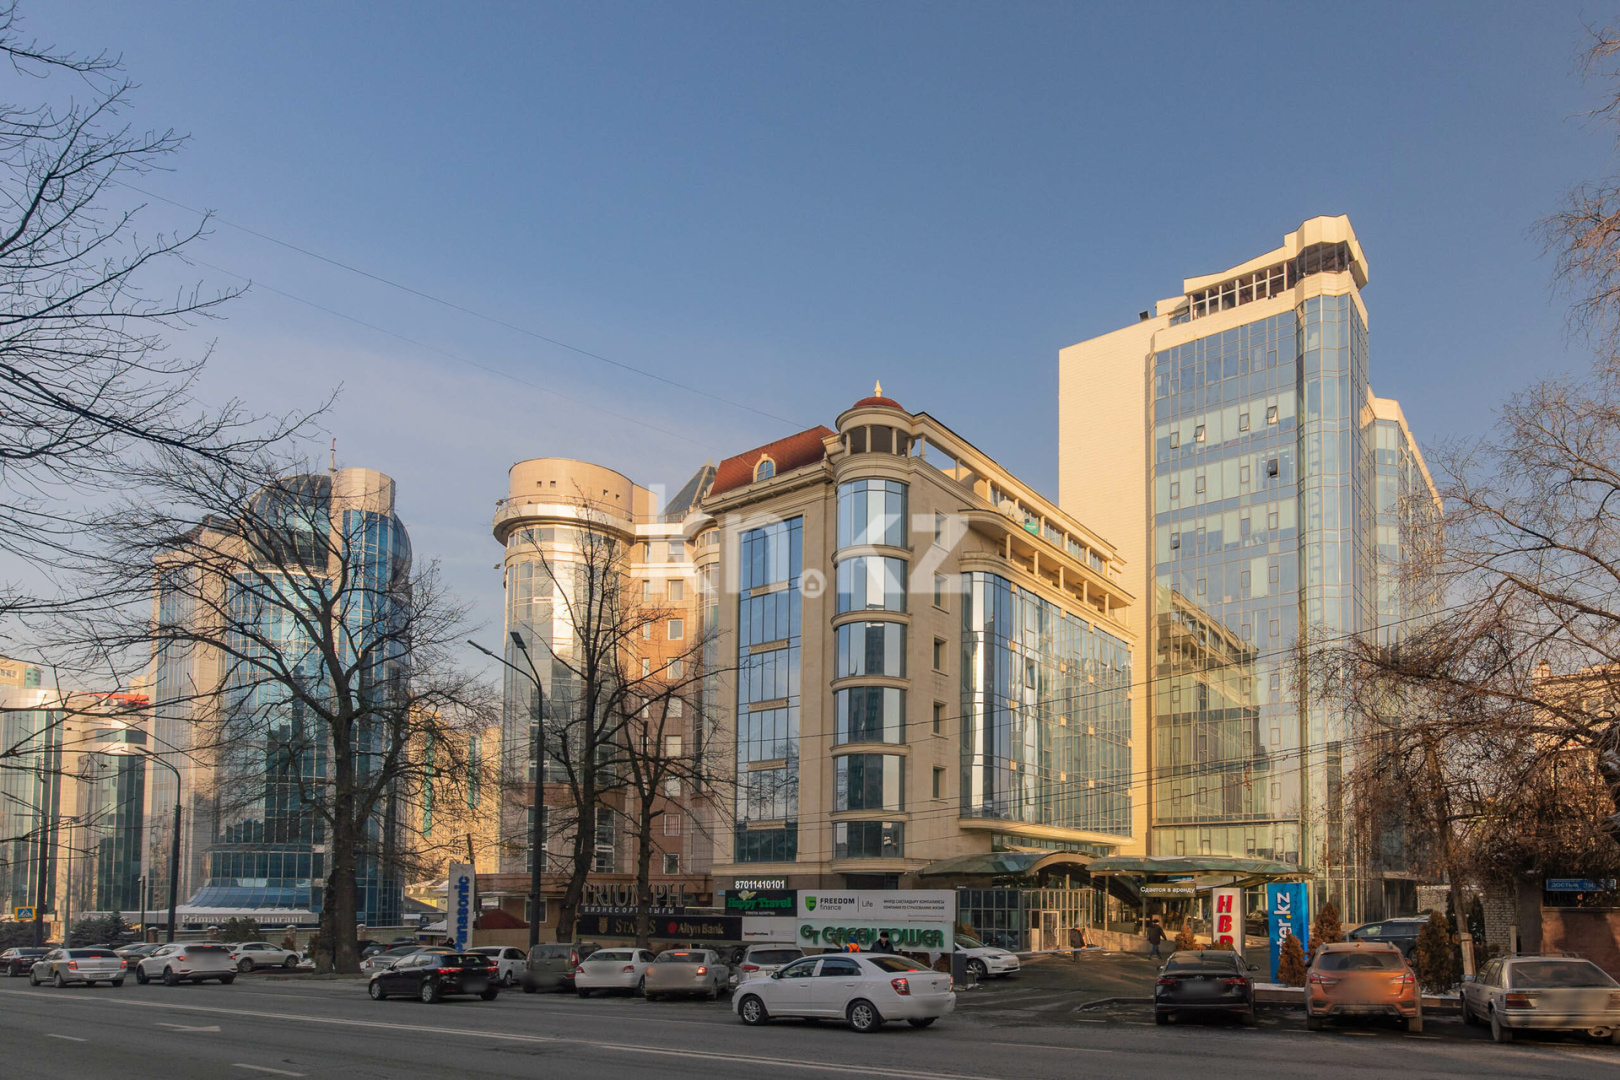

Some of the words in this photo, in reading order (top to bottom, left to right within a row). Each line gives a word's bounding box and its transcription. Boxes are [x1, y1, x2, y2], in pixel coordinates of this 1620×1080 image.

[735, 880, 785, 889] 87011410101
[728, 897, 756, 910] Happy
[757, 897, 792, 908] Travel
[820, 897, 855, 905] FREEDOM
[454, 875, 470, 952] Panasonic
[615, 919, 656, 934] STAS
[678, 923, 700, 936] Altyn
[702, 923, 724, 935] Bank
